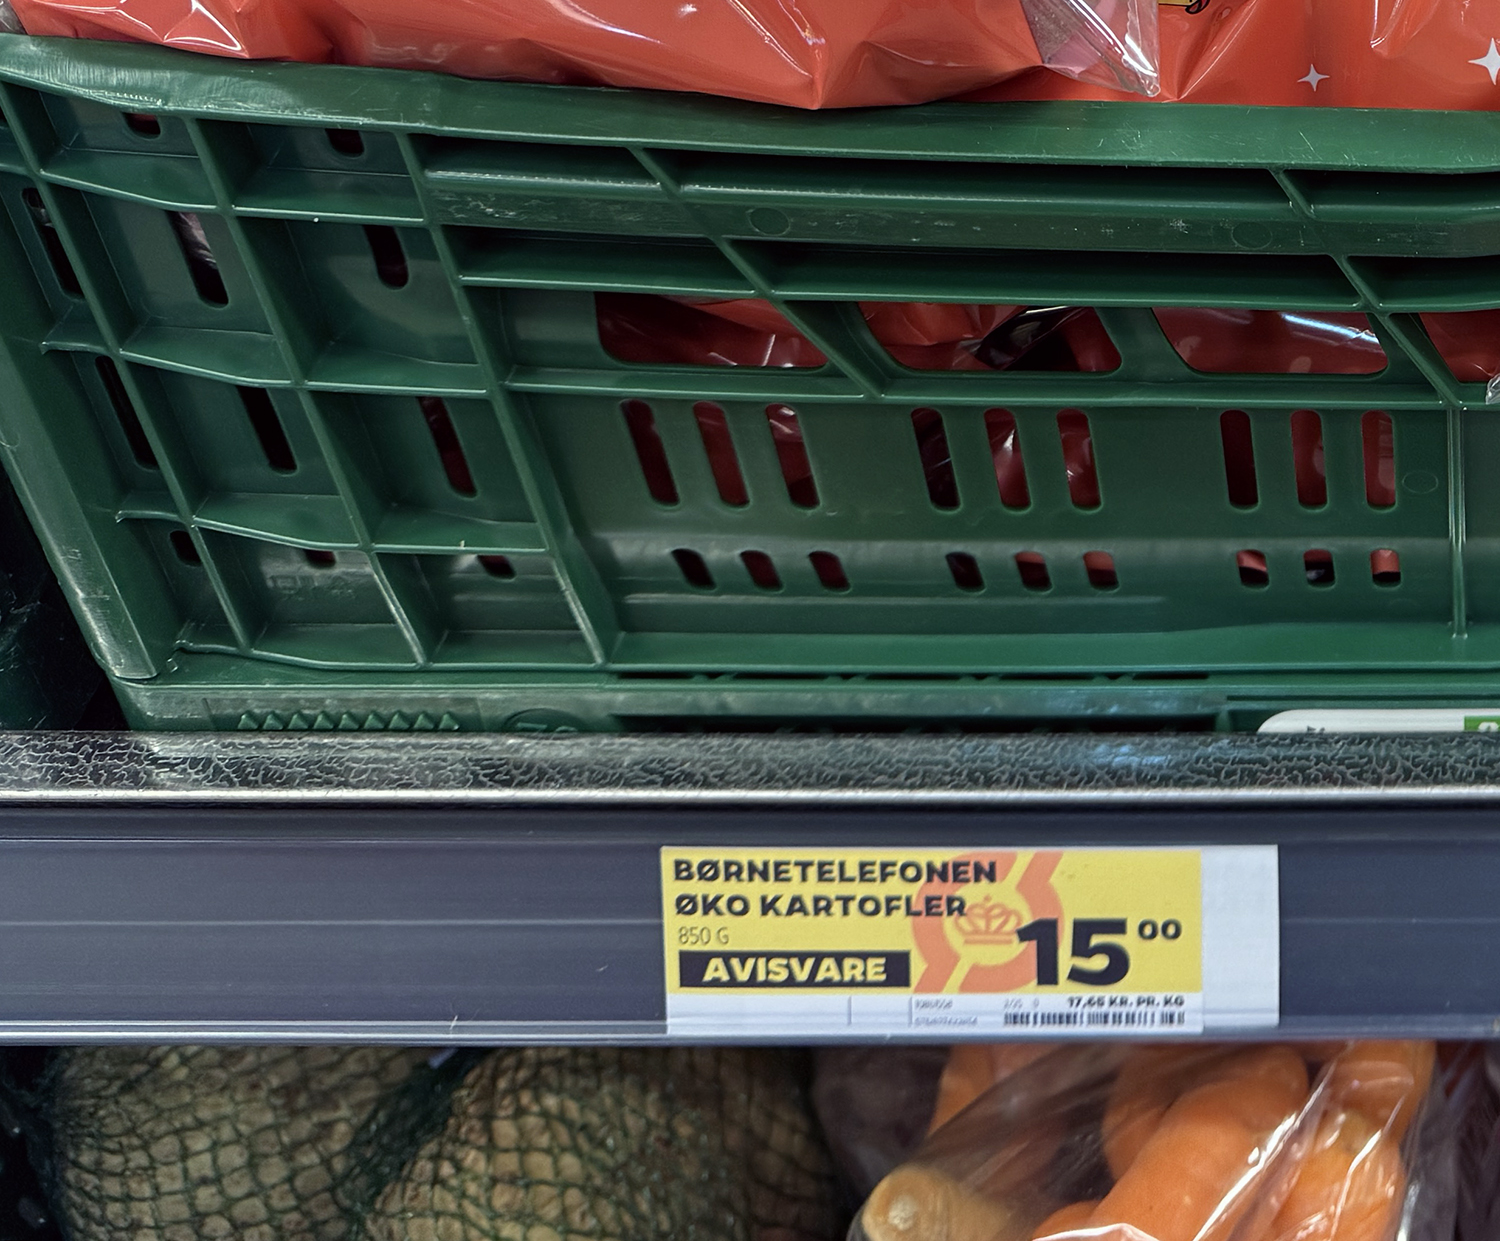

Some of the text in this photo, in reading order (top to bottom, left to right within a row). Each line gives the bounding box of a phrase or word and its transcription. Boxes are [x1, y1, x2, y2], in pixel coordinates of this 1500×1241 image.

[673, 858, 998, 885] BØRNETELEFONEN
[675, 894, 968, 918] ØKO KARTOFLER
[678, 925, 730, 946] 850 G
[1016, 917, 1128, 987] 15
[702, 956, 888, 983] AVISVARE
